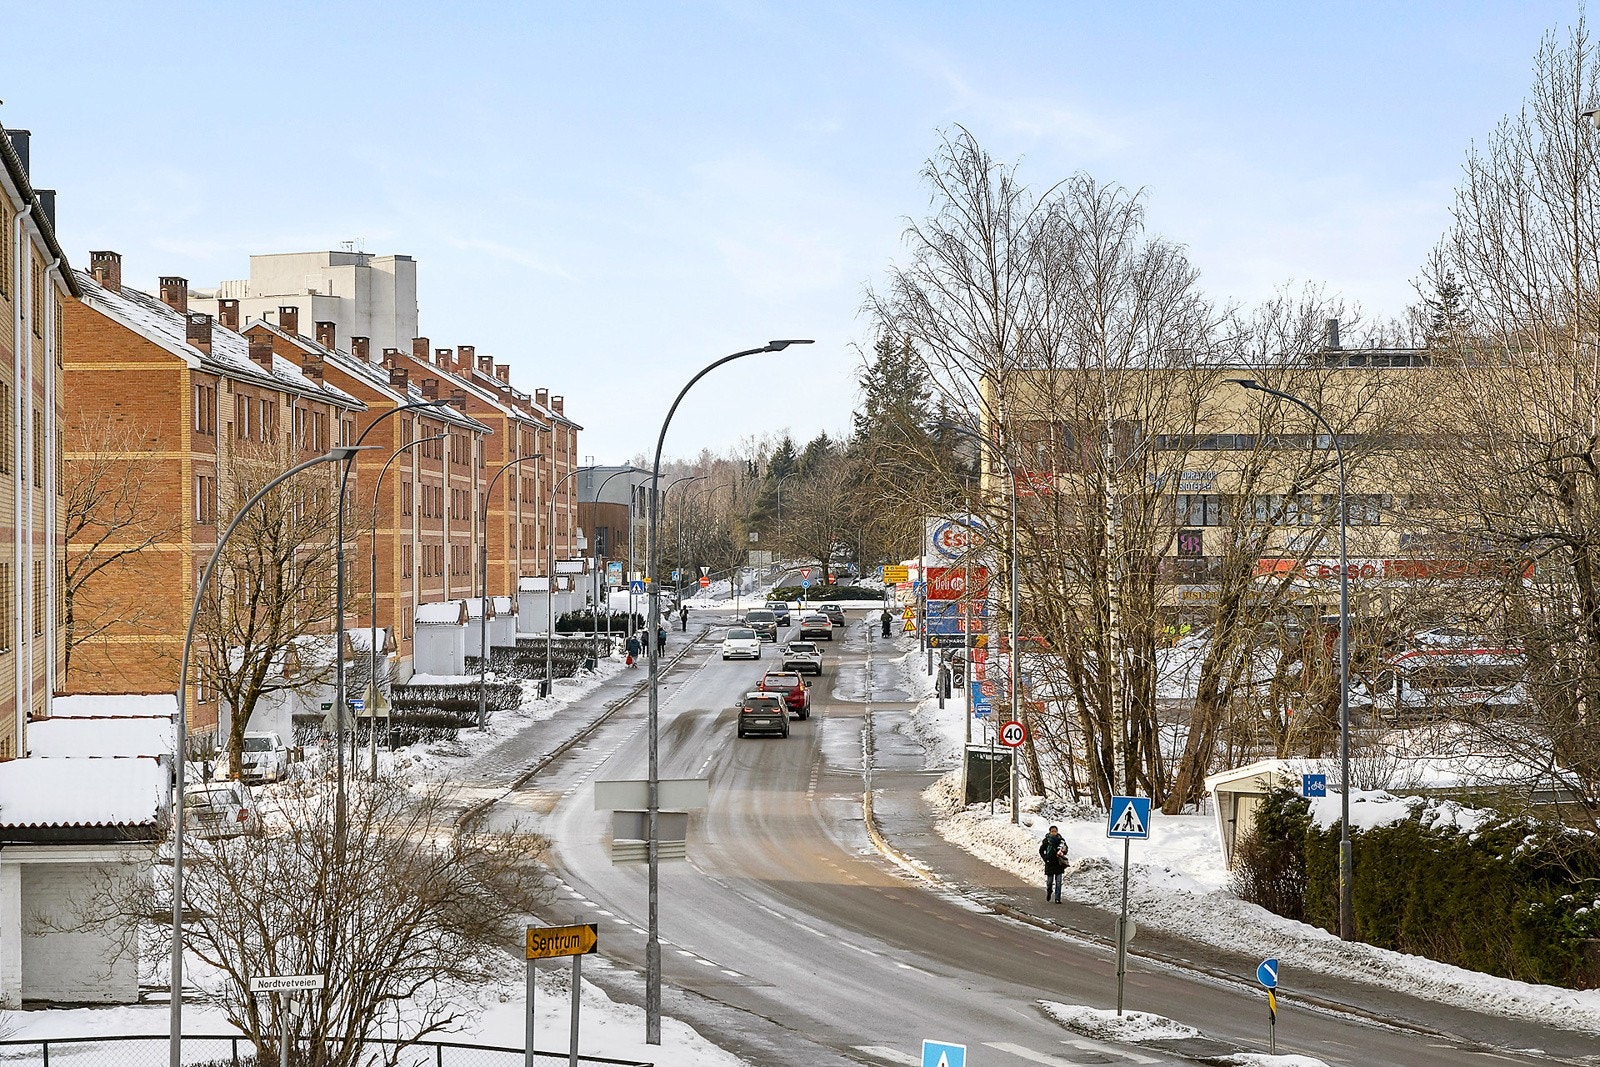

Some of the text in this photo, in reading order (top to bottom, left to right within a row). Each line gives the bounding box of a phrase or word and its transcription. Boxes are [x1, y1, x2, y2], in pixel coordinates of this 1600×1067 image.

[1004, 728, 1022, 741] 40
[532, 933, 580, 952] Sentrum
[257, 978, 317, 989] Nordtvetveien
